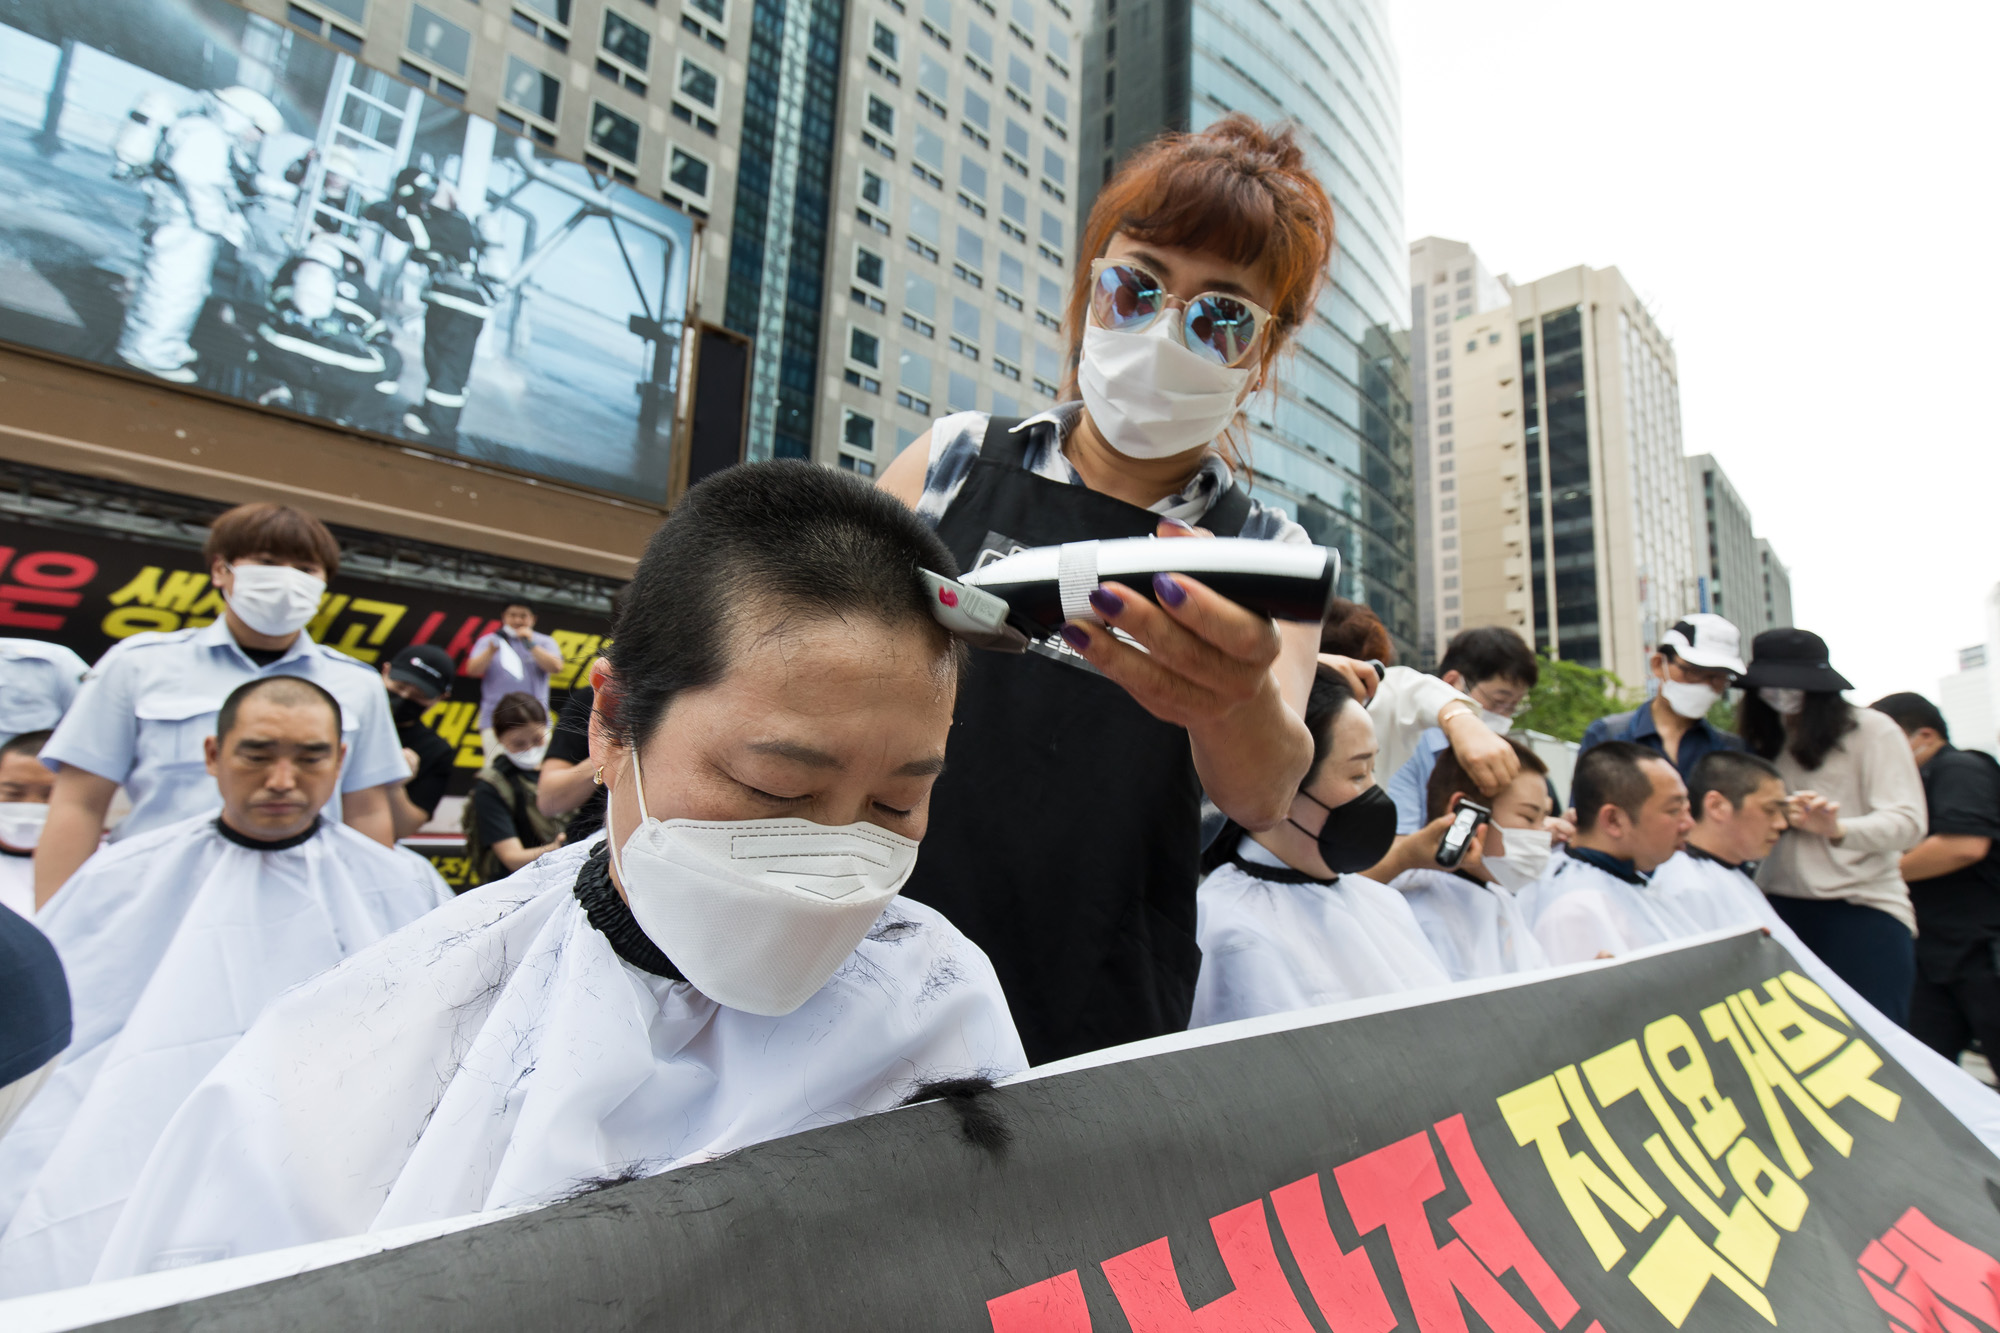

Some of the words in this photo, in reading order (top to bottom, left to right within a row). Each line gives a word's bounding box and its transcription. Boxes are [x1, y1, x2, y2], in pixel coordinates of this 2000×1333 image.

[0, 546, 98, 631] 은
[101, 566, 408, 665] 생고
[1497, 1014, 1810, 1330] 직고용
